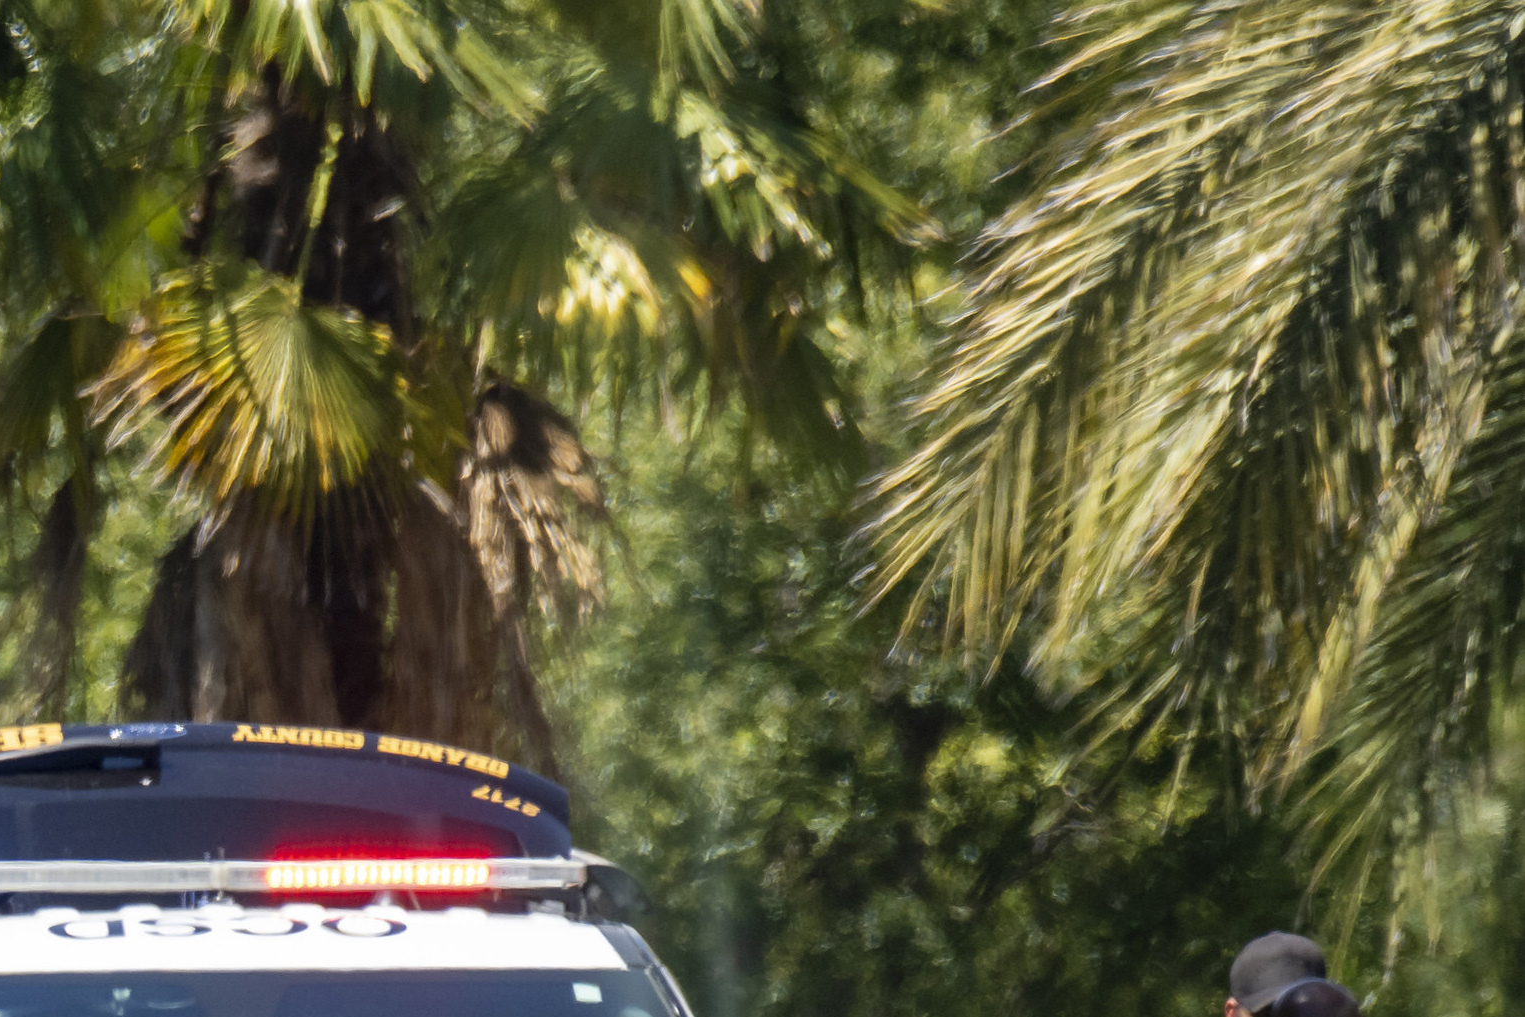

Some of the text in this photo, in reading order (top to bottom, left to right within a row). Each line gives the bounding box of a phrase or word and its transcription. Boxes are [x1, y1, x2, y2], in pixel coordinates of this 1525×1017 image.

[231, 724, 510, 780] ORANGE COUNTY
[471, 784, 541, 818] 2717
[47, 914, 408, 940] OCSD
